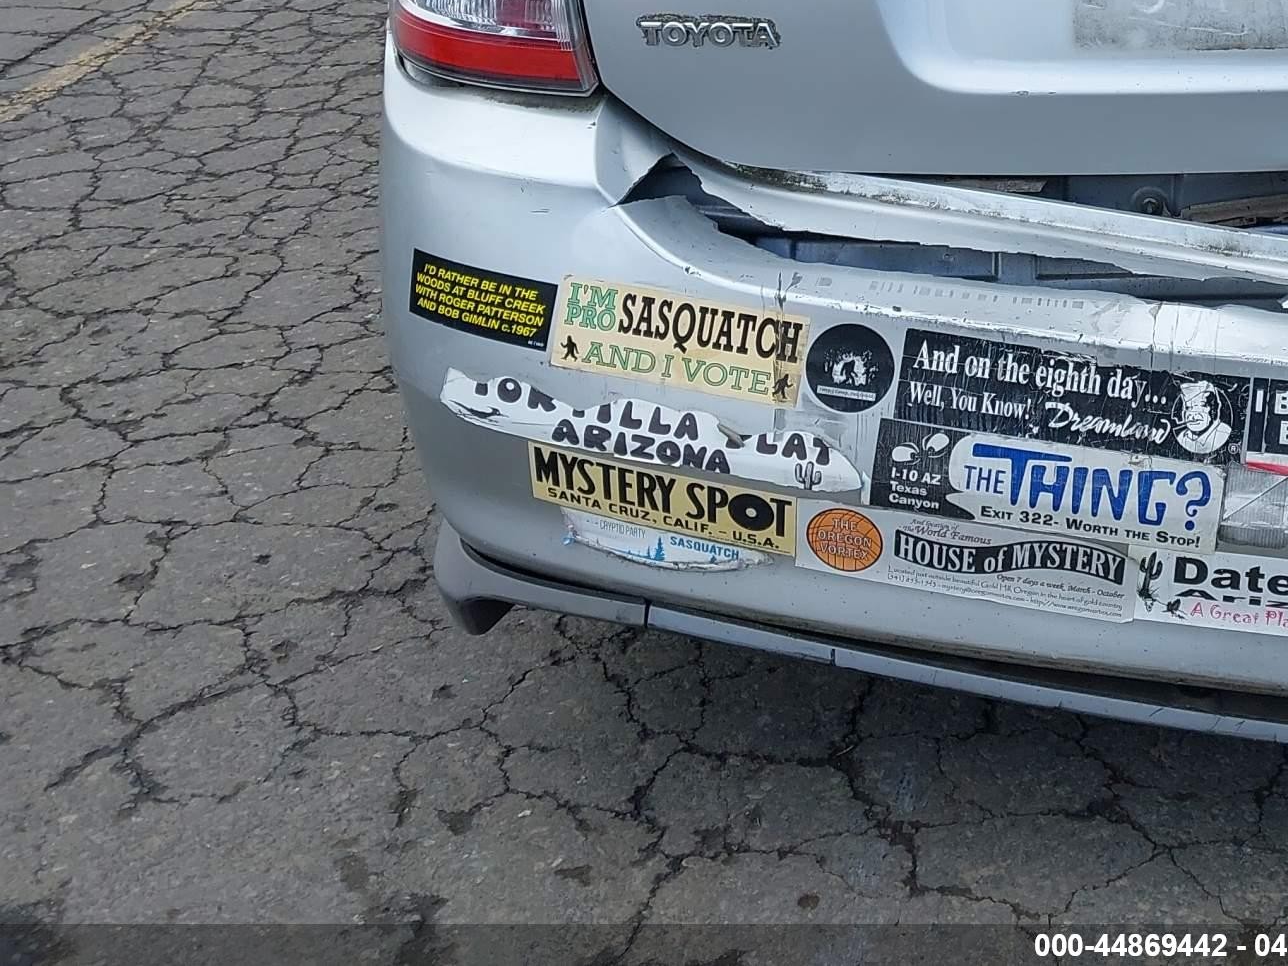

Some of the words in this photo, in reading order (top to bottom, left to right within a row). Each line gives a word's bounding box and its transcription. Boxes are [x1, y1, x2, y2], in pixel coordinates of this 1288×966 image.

[640, 20, 779, 47] TOYOTA
[416, 272, 451, 292] WOODS
[451, 285, 467, 296] AT
[467, 289, 503, 305] BLUFF
[504, 298, 546, 314] CREEK
[424, 263, 437, 274] I'D
[437, 268, 480, 288] RATHER
[480, 280, 498, 292] BE
[498, 284, 512, 295] IN
[514, 287, 538, 300] THE
[567, 282, 618, 310] I'M
[415, 284, 438, 300] WITH
[438, 292, 476, 312] ROGER
[476, 303, 545, 327] PATTERSON
[417, 297, 437, 311] AND
[437, 305, 460, 319] BOB
[461, 312, 500, 331] GIMLIN
[501, 323, 538, 338] c.1967
[563, 302, 617, 332] PRO
[618, 292, 804, 364] SASQUATCH
[581, 341, 656, 374] AND
[661, 354, 674, 379] I
[681, 357, 772, 396] VOTE
[912, 339, 960, 375] And
[964, 354, 991, 380] on
[997, 352, 1030, 384] the
[1035, 358, 1102, 397] eighth
[1106, 368, 1168, 408] day...
[909, 380, 945, 411] Well,
[949, 387, 977, 411] You
[981, 394, 1032, 420] Know!
[1254, 389, 1264, 413] I
[1045, 401, 1172, 444] Dreamland
[552, 418, 731, 474] ARIZONA
[890, 480, 928, 496] Texas
[891, 466, 919, 482] I-10
[920, 472, 941, 485] AZ
[964, 464, 1005, 494] THE
[971, 442, 1213, 531] THING?
[534, 446, 676, 514] MYSTERY
[685, 481, 793, 537] SPOT
[888, 492, 940, 510] Canyon
[547, 487, 601, 511] SANTA
[608, 503, 658, 524] CRUZ,
[662, 515, 713, 536] CALIF.
[732, 530, 780, 550] U.S.A.
[625, 525, 647, 539] PARTY
[832, 518, 858, 531] THE
[1019, 510, 1060, 526] 322-
[670, 536, 740, 559] SASQUATCH
[817, 530, 872, 548] OREGON
[915, 525, 948, 538] World
[950, 530, 992, 545] Famous
[819, 542, 869, 560] VORTEX
[899, 533, 976, 573] HOUSE
[983, 547, 1007, 573] of
[1011, 542, 1121, 581] MYSTERY
[997, 574, 1016, 584] Open
[1022, 577, 1039, 587] days
[1097, 589, 1125, 599] October
[1190, 602, 1204, 618] A
[1209, 604, 1259, 624] Great
